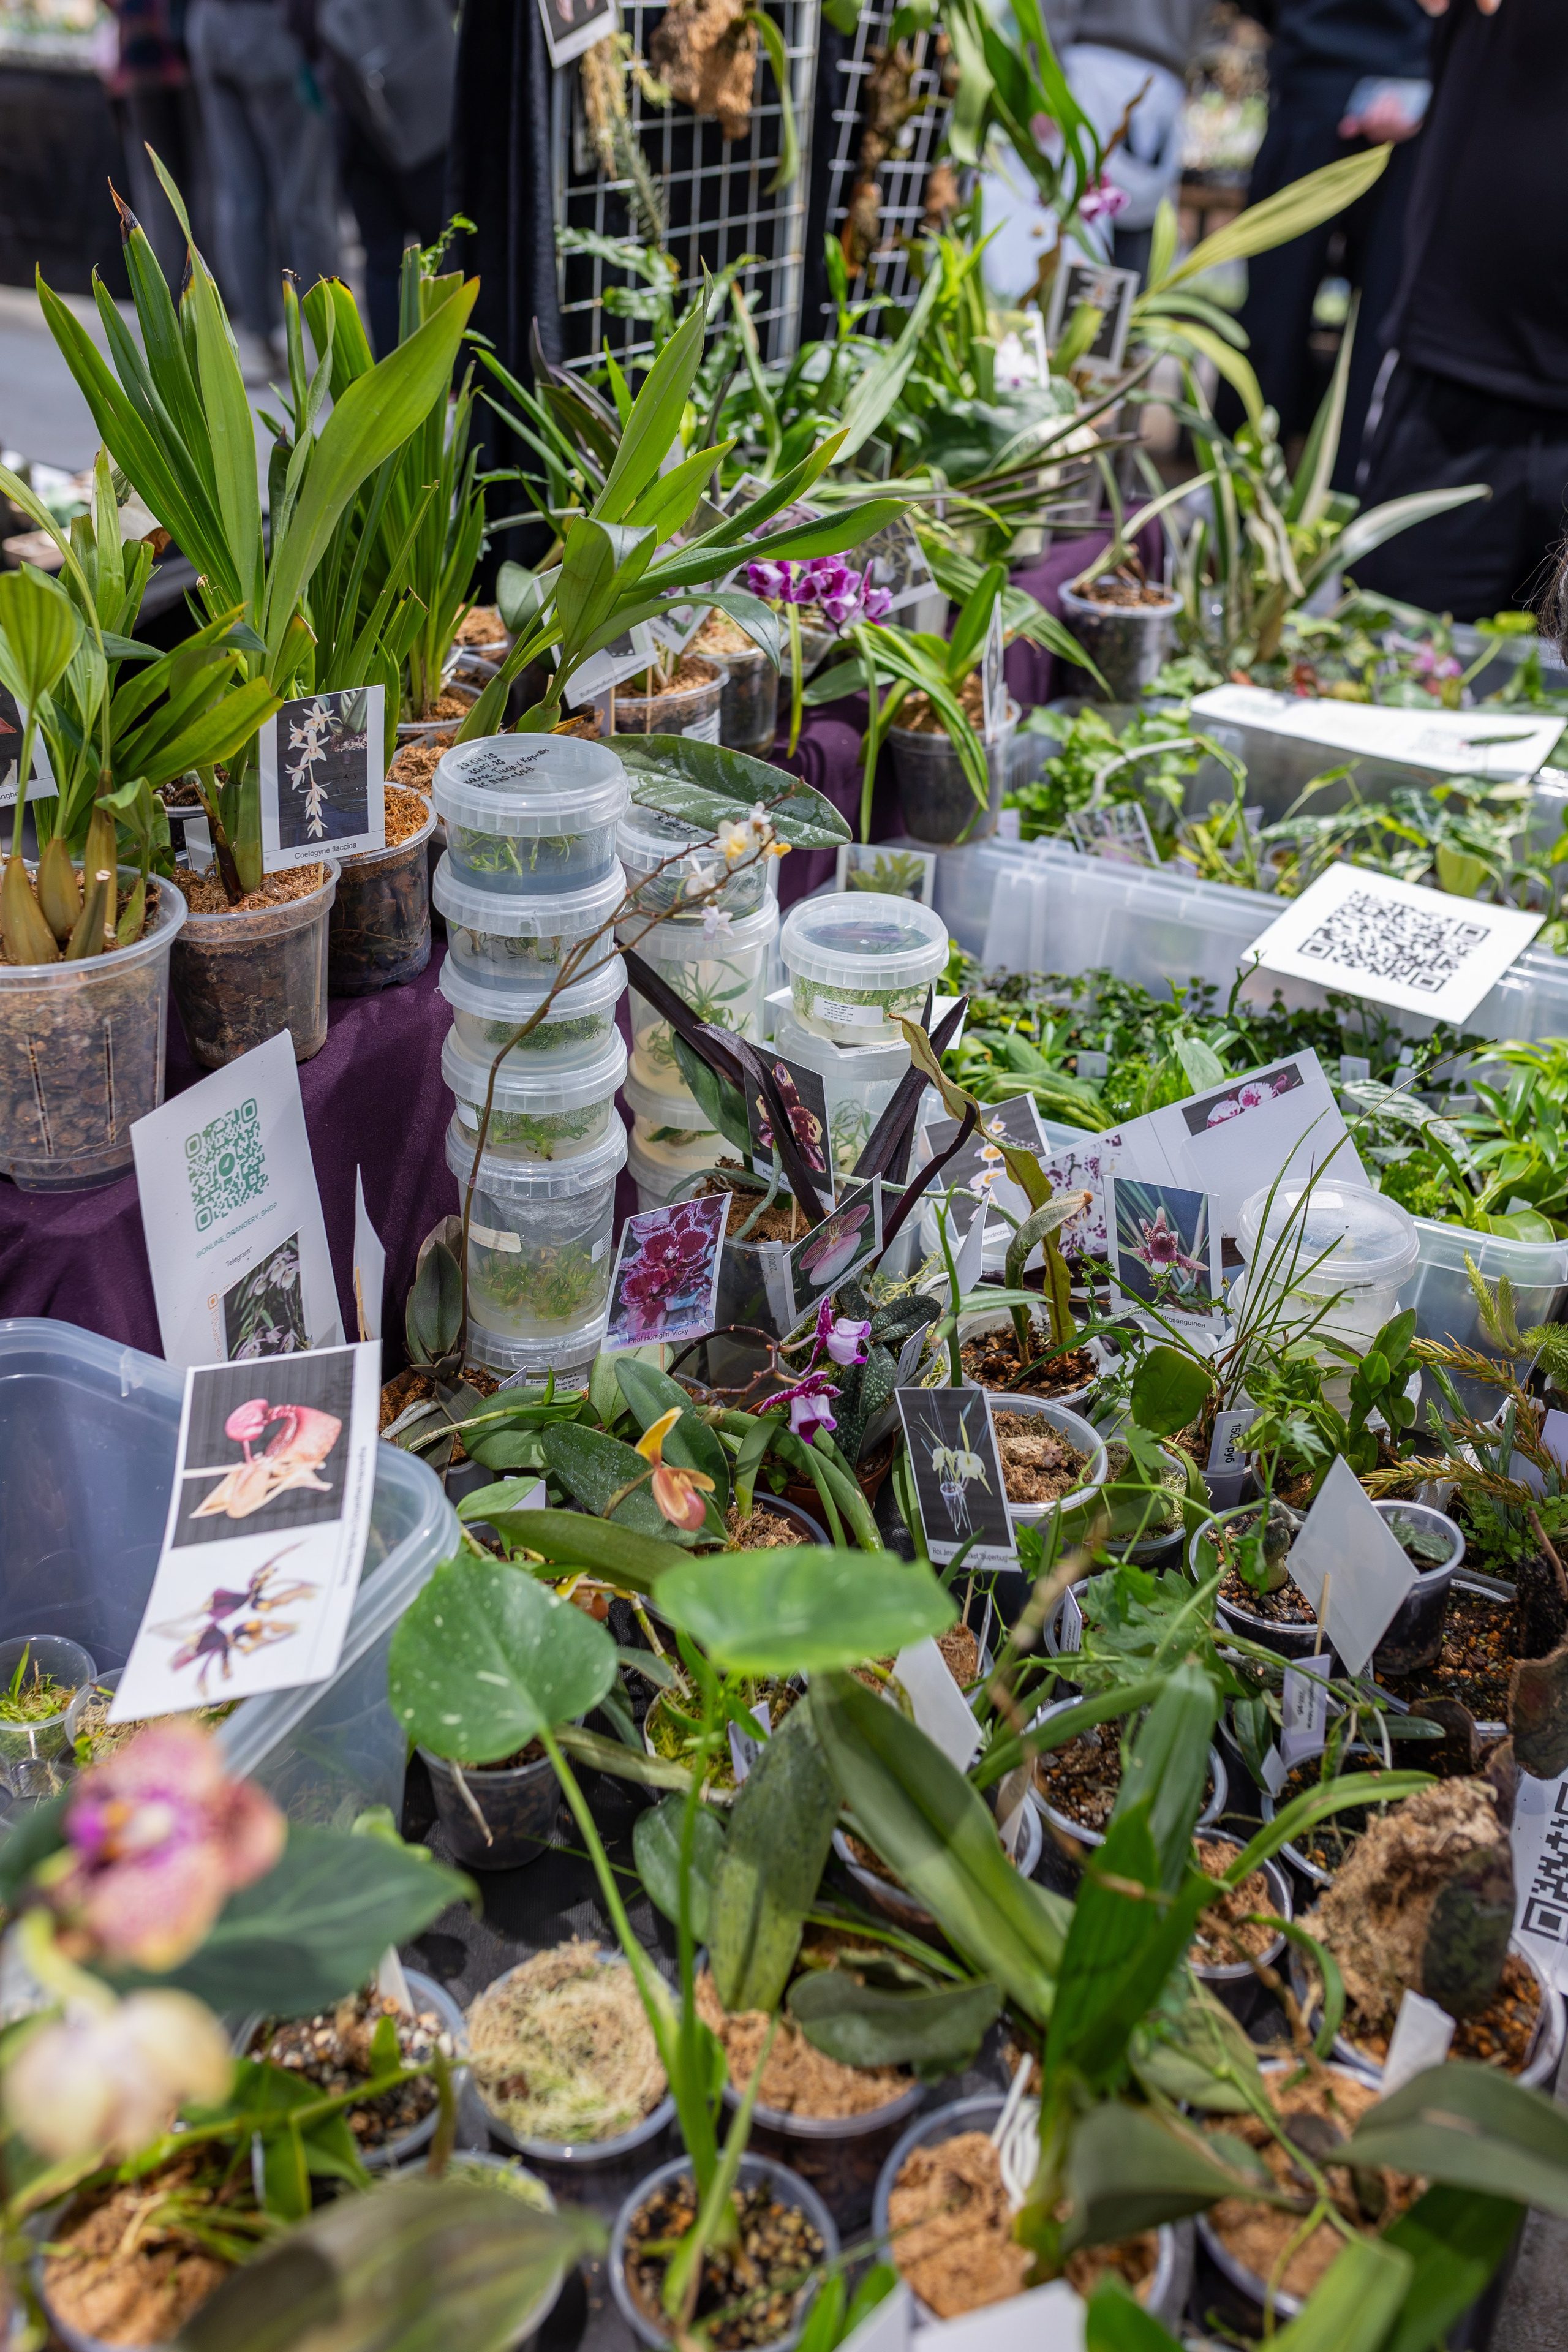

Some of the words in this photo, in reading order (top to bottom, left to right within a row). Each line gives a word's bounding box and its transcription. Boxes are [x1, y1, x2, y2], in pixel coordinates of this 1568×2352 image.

[295, 848, 330, 859] Coelogyne
[332, 843, 356, 852] flaccida
[196, 1202, 277, 1258] @ONLINE_ORANGERY_SHOP
[842, 1256, 871, 1283] micranthum
[1160, 1314, 1205, 1328] Atrosanguinea
[1224, 1447, 1235, 1463] руб
